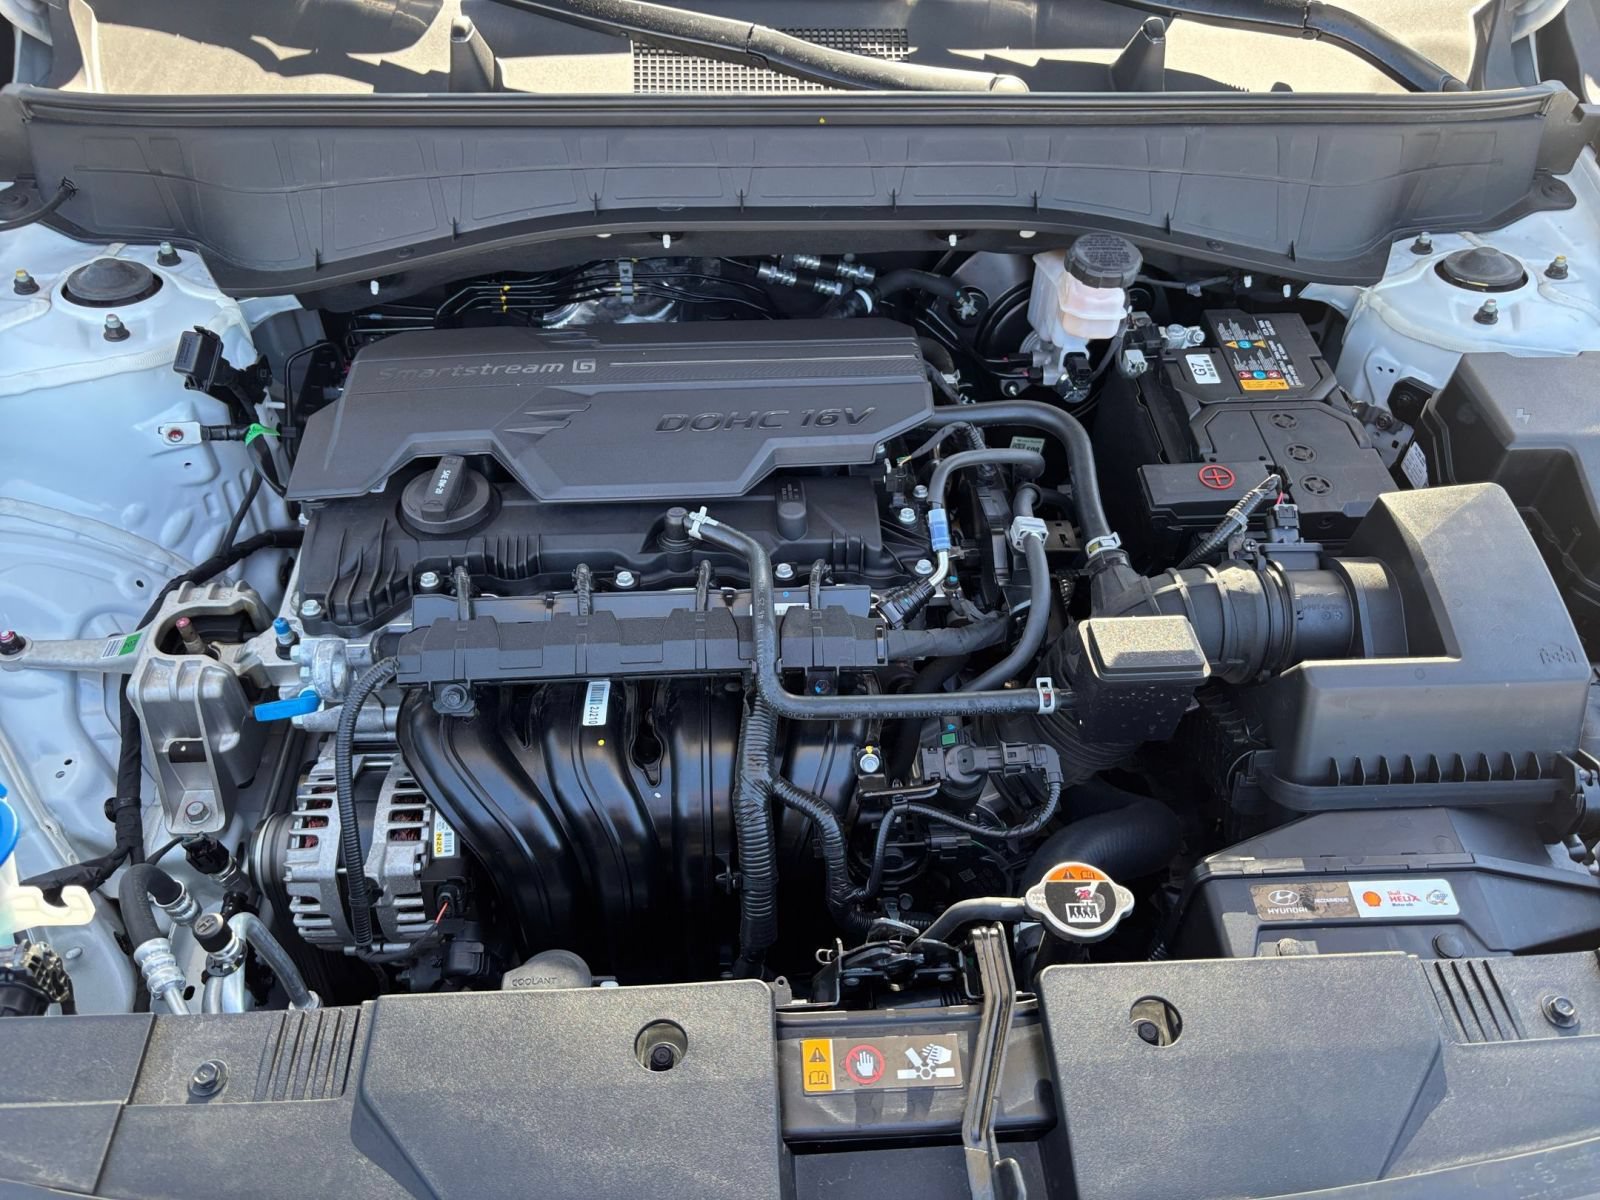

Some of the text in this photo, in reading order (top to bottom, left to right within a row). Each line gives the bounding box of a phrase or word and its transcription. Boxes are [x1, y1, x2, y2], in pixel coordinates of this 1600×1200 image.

[379, 362, 565, 380] Smartstream
[1191, 362, 1207, 376] G7
[655, 406, 877, 432] DOHC 16V
[435, 833, 443, 853] N20
[1389, 893, 1422, 903] HELIX
[1267, 906, 1308, 915] HYUNDAI
[511, 976, 558, 987] COOLANT
